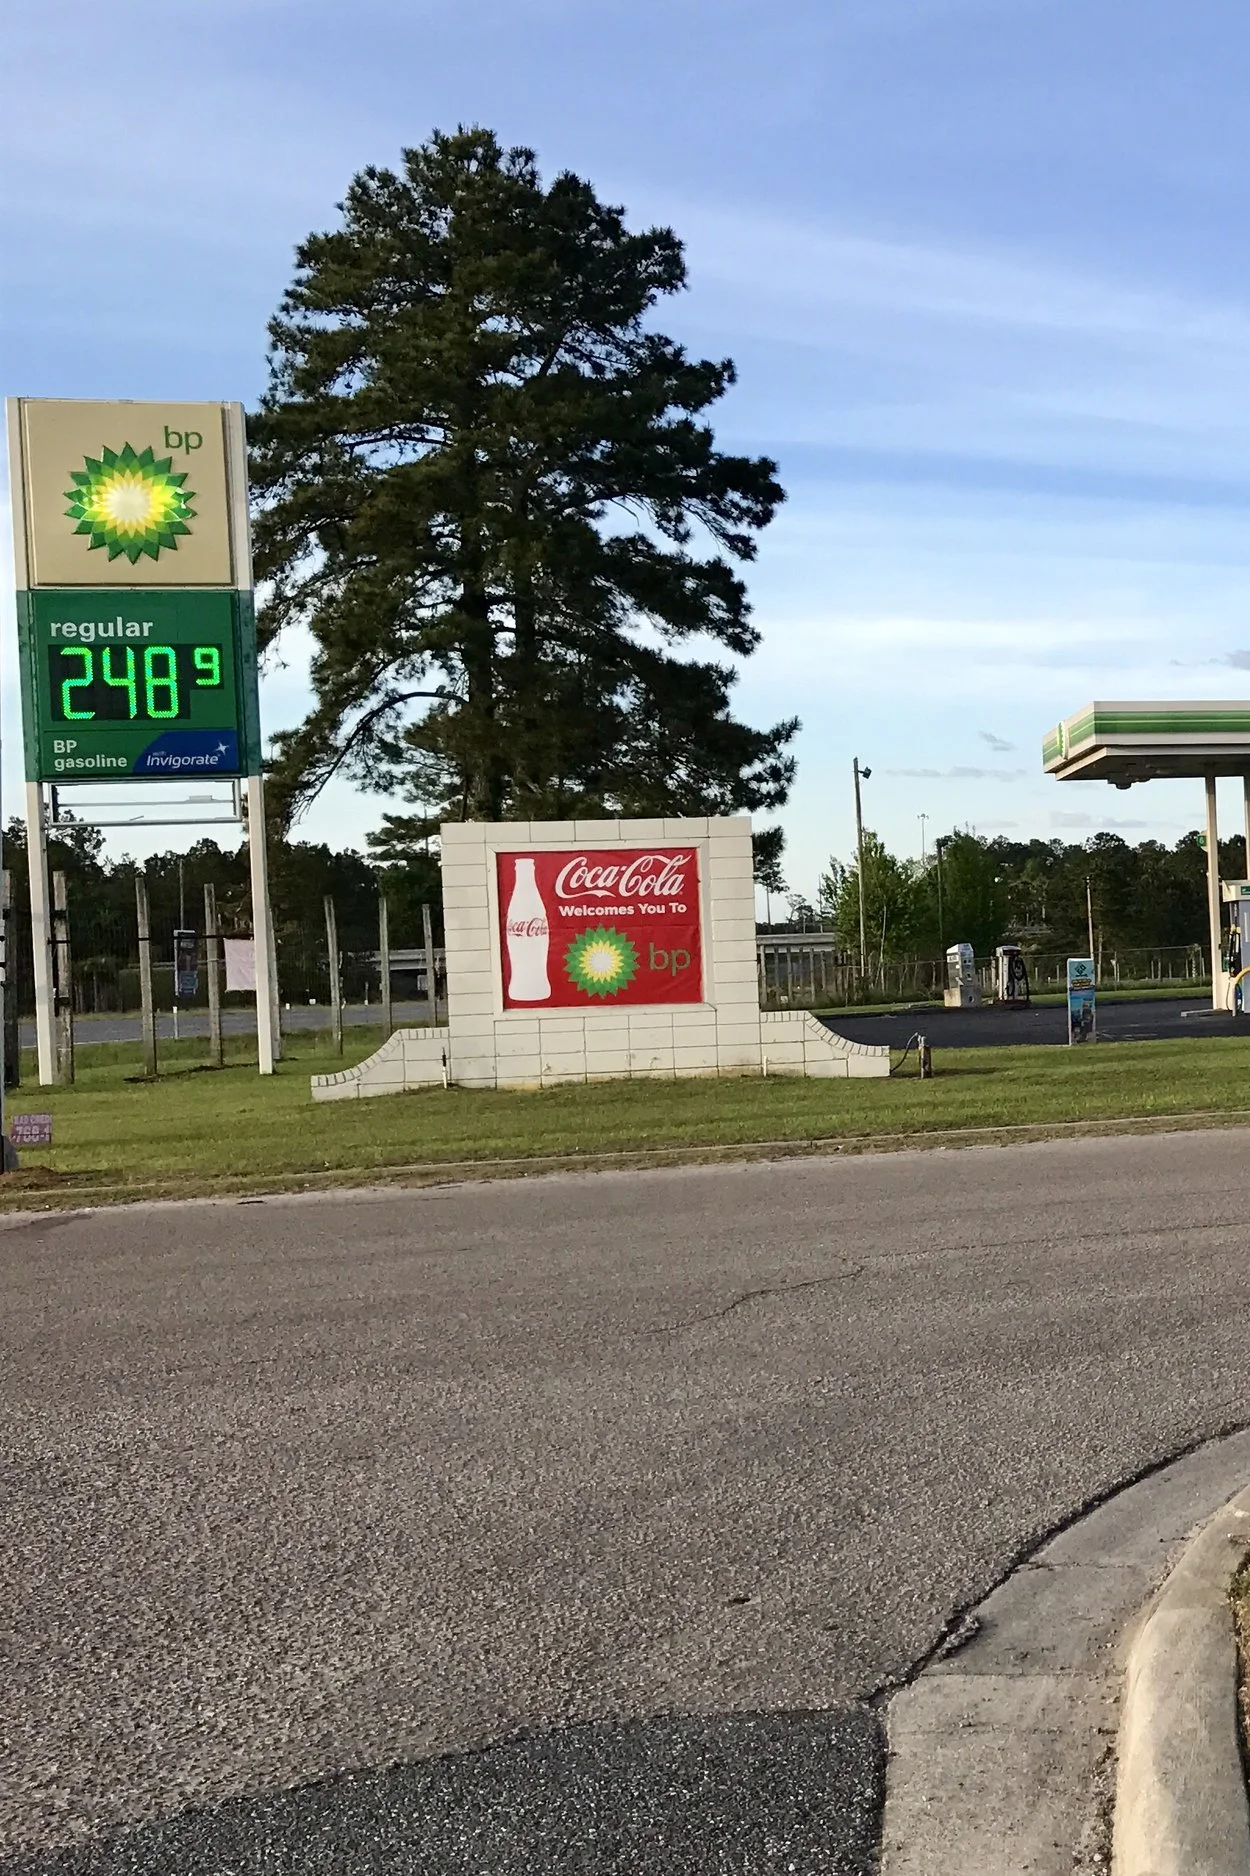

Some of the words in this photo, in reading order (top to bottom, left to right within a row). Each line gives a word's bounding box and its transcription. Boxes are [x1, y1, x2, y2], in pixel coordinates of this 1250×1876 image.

[164, 426, 203, 455] bp
[50, 617, 153, 642] regular
[61, 646, 179, 719] 248
[194, 647, 220, 685] 9
[53, 739, 77, 753] BP
[54, 754, 127, 771] gasoline
[147, 754, 219, 769] Invigorate
[555, 855, 692, 898] Coca-Cola
[559, 904, 634, 916] Welcomes
[638, 903, 665, 914] You
[669, 902, 687, 913] To
[650, 942, 691, 976] bp
